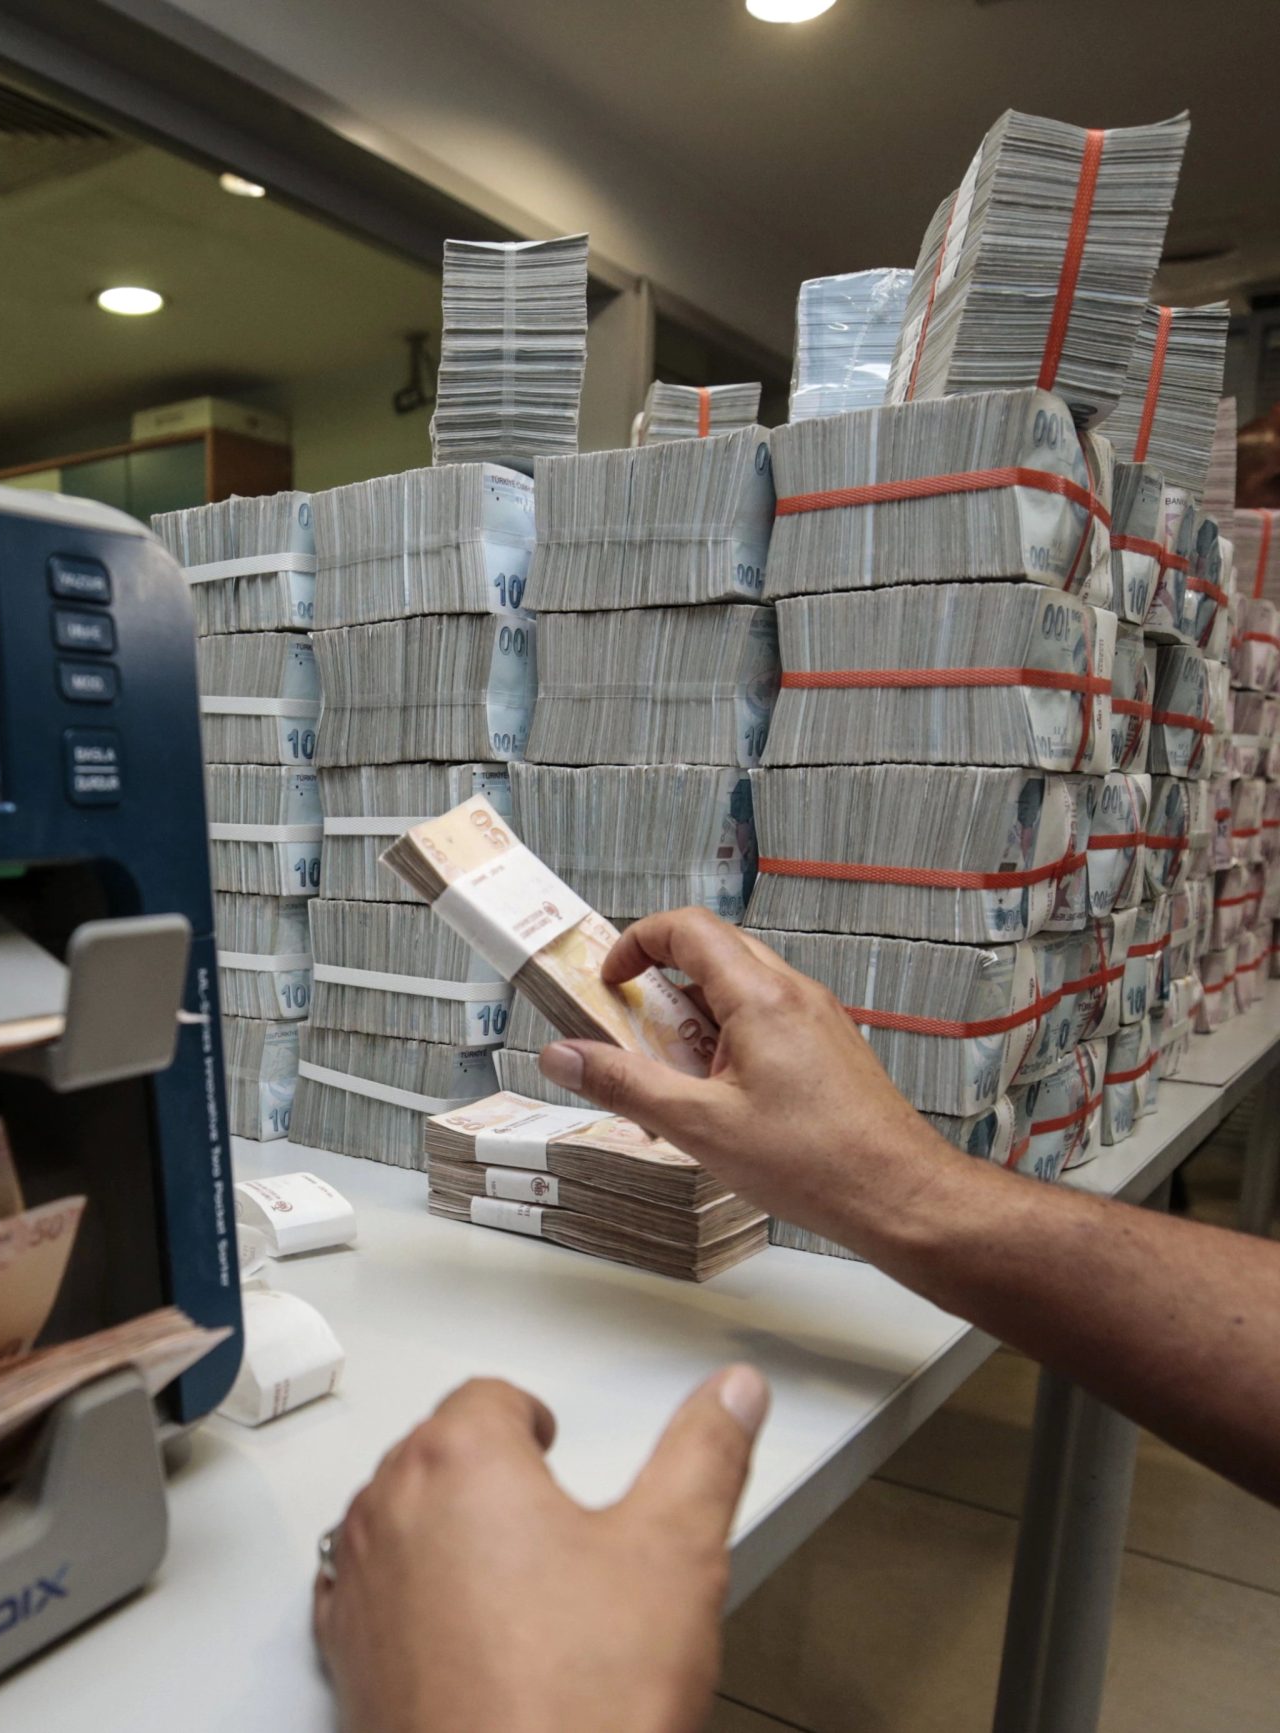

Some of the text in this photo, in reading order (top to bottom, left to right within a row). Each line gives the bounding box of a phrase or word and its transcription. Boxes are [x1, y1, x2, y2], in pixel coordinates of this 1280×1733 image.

[287, 728, 316, 759] 10
[745, 726, 767, 757] 10
[470, 809, 511, 850] 50
[294, 858, 320, 888] 10
[477, 1003, 508, 1036] 10
[269, 1108, 291, 1132] 10
